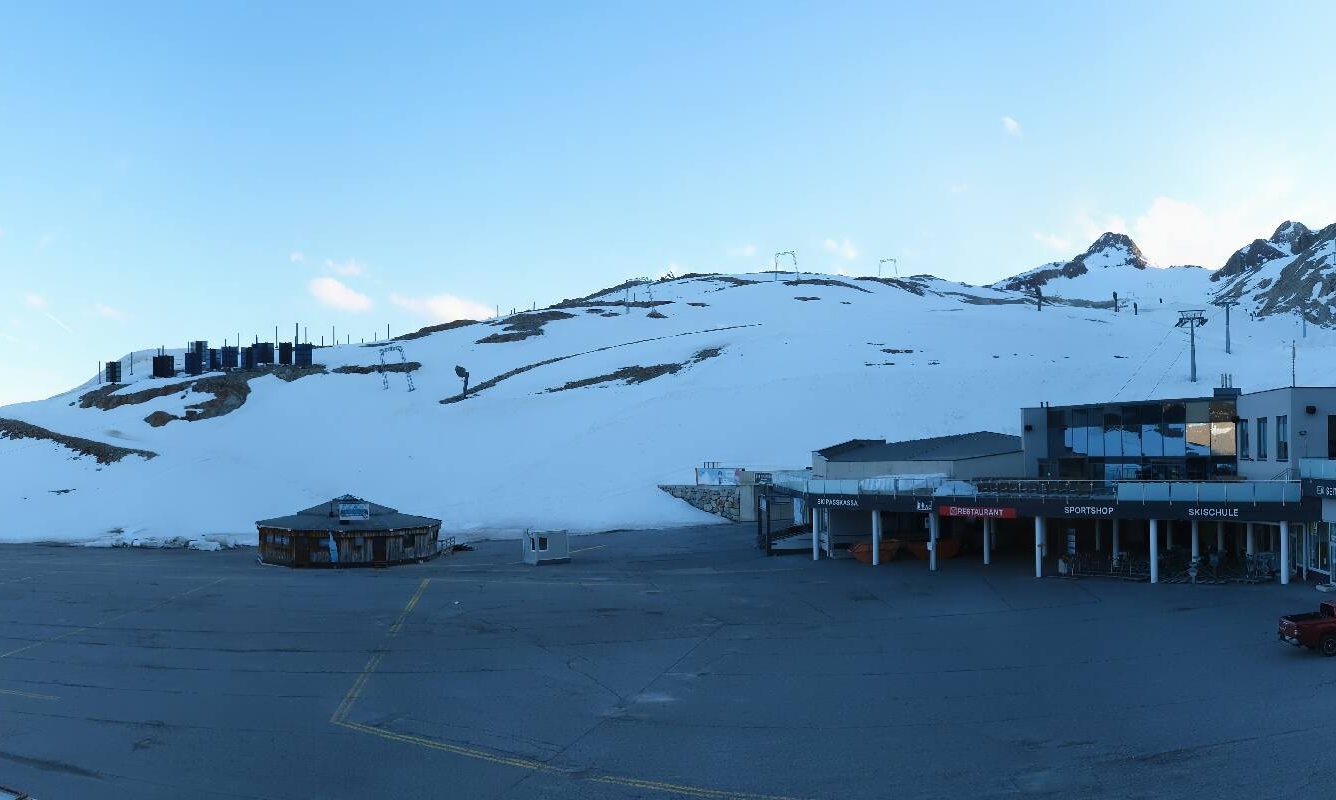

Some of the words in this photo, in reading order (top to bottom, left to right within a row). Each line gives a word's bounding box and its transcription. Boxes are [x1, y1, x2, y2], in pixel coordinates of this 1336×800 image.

[957, 507, 1004, 516] RESTAURANT
[1064, 506, 1114, 515] SPORTSHOP
[1188, 508, 1239, 517] SKISCHULE
